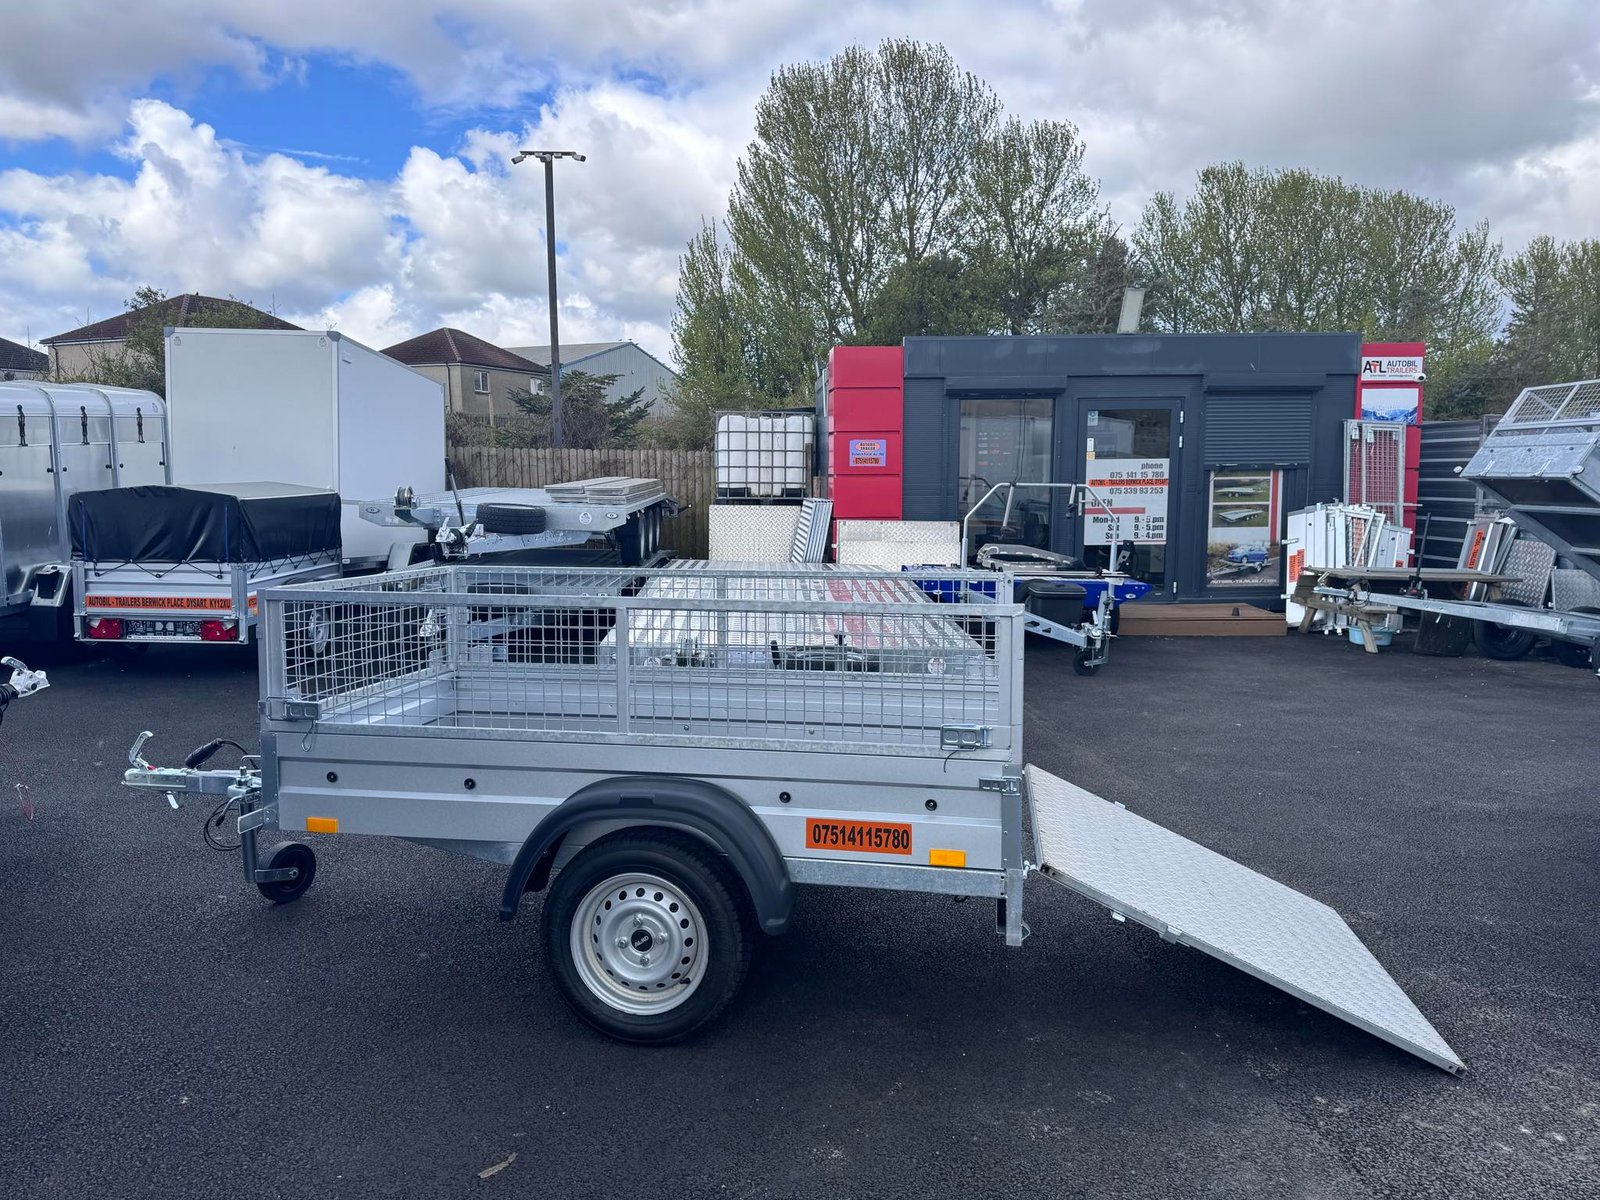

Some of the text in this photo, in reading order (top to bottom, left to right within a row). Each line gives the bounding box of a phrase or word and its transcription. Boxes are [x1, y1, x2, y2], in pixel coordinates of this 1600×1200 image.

[1363, 360, 1386, 373] ATL
[1091, 498, 1112, 507] OEN
[88, 597, 111, 606] AUTOBIL
[115, 597, 140, 606] TRAILERS
[141, 597, 165, 606] BERWICK
[812, 823, 910, 850] 07514115780
